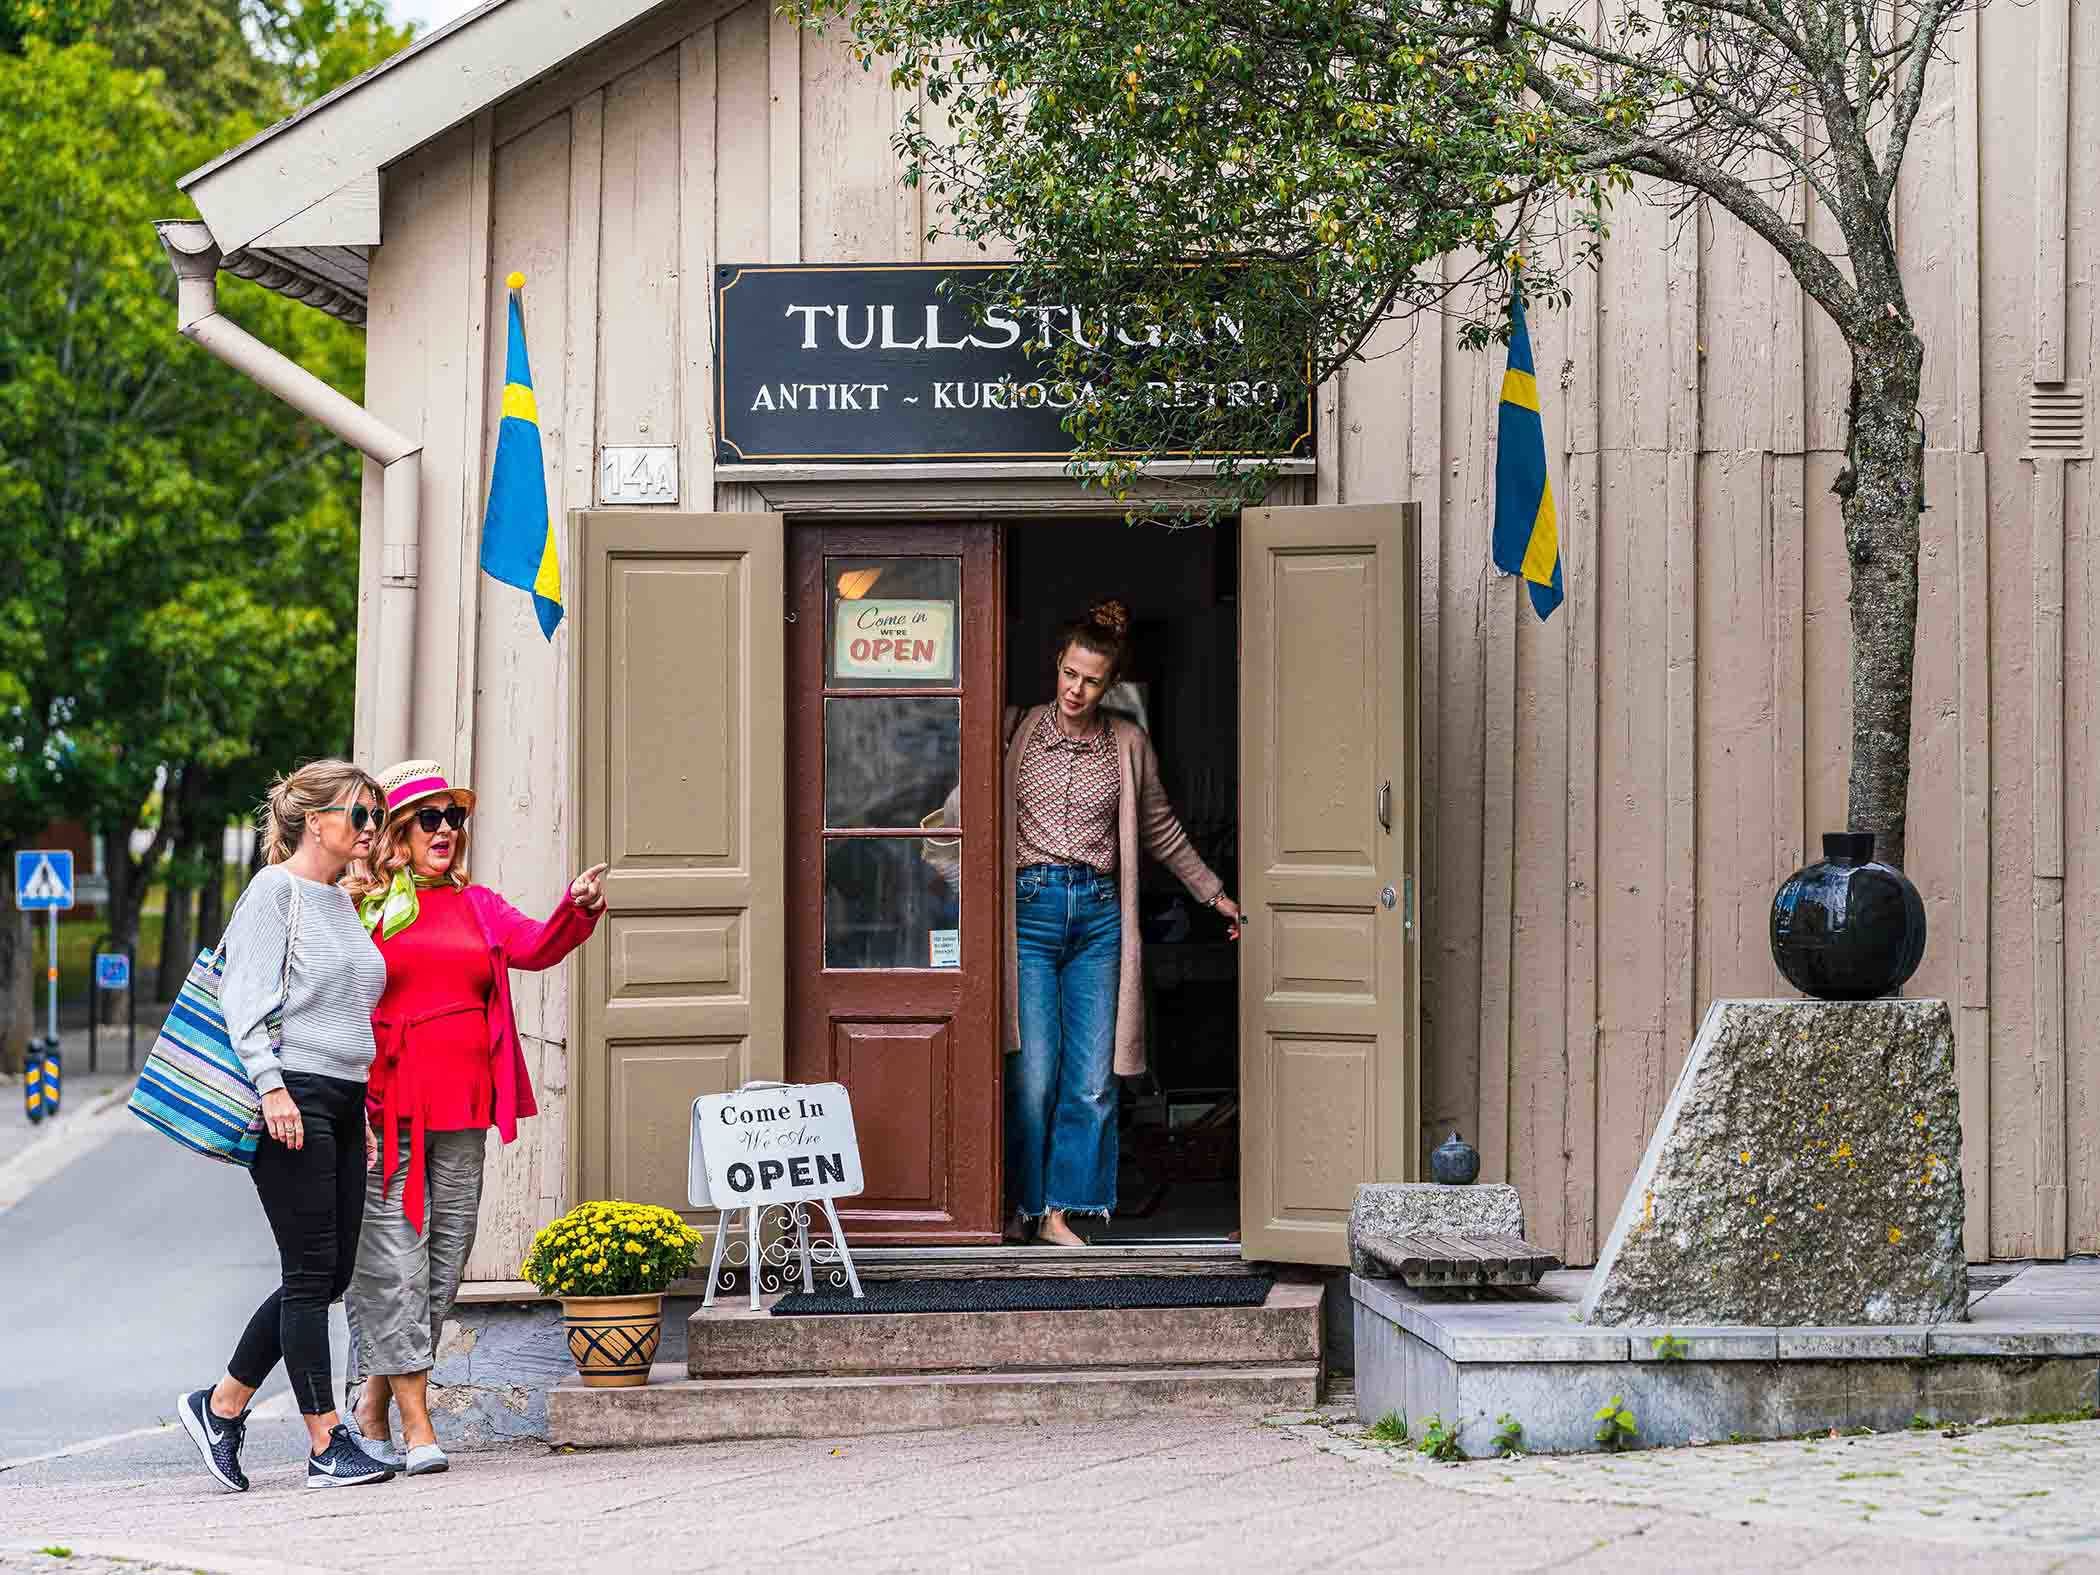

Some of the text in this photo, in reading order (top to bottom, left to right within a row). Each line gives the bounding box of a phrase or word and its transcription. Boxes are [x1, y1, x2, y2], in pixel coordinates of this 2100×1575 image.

[785, 302, 1245, 349] TULLSTUGN
[750, 383, 888, 412] ANTIKT
[604, 449, 673, 495] 14A
[857, 606, 927, 630] Come in
[850, 638, 934, 661] OPEN
[720, 1099, 825, 1126] Come In
[739, 1126, 822, 1152] We Are
[727, 1153, 846, 1193] OPEN
